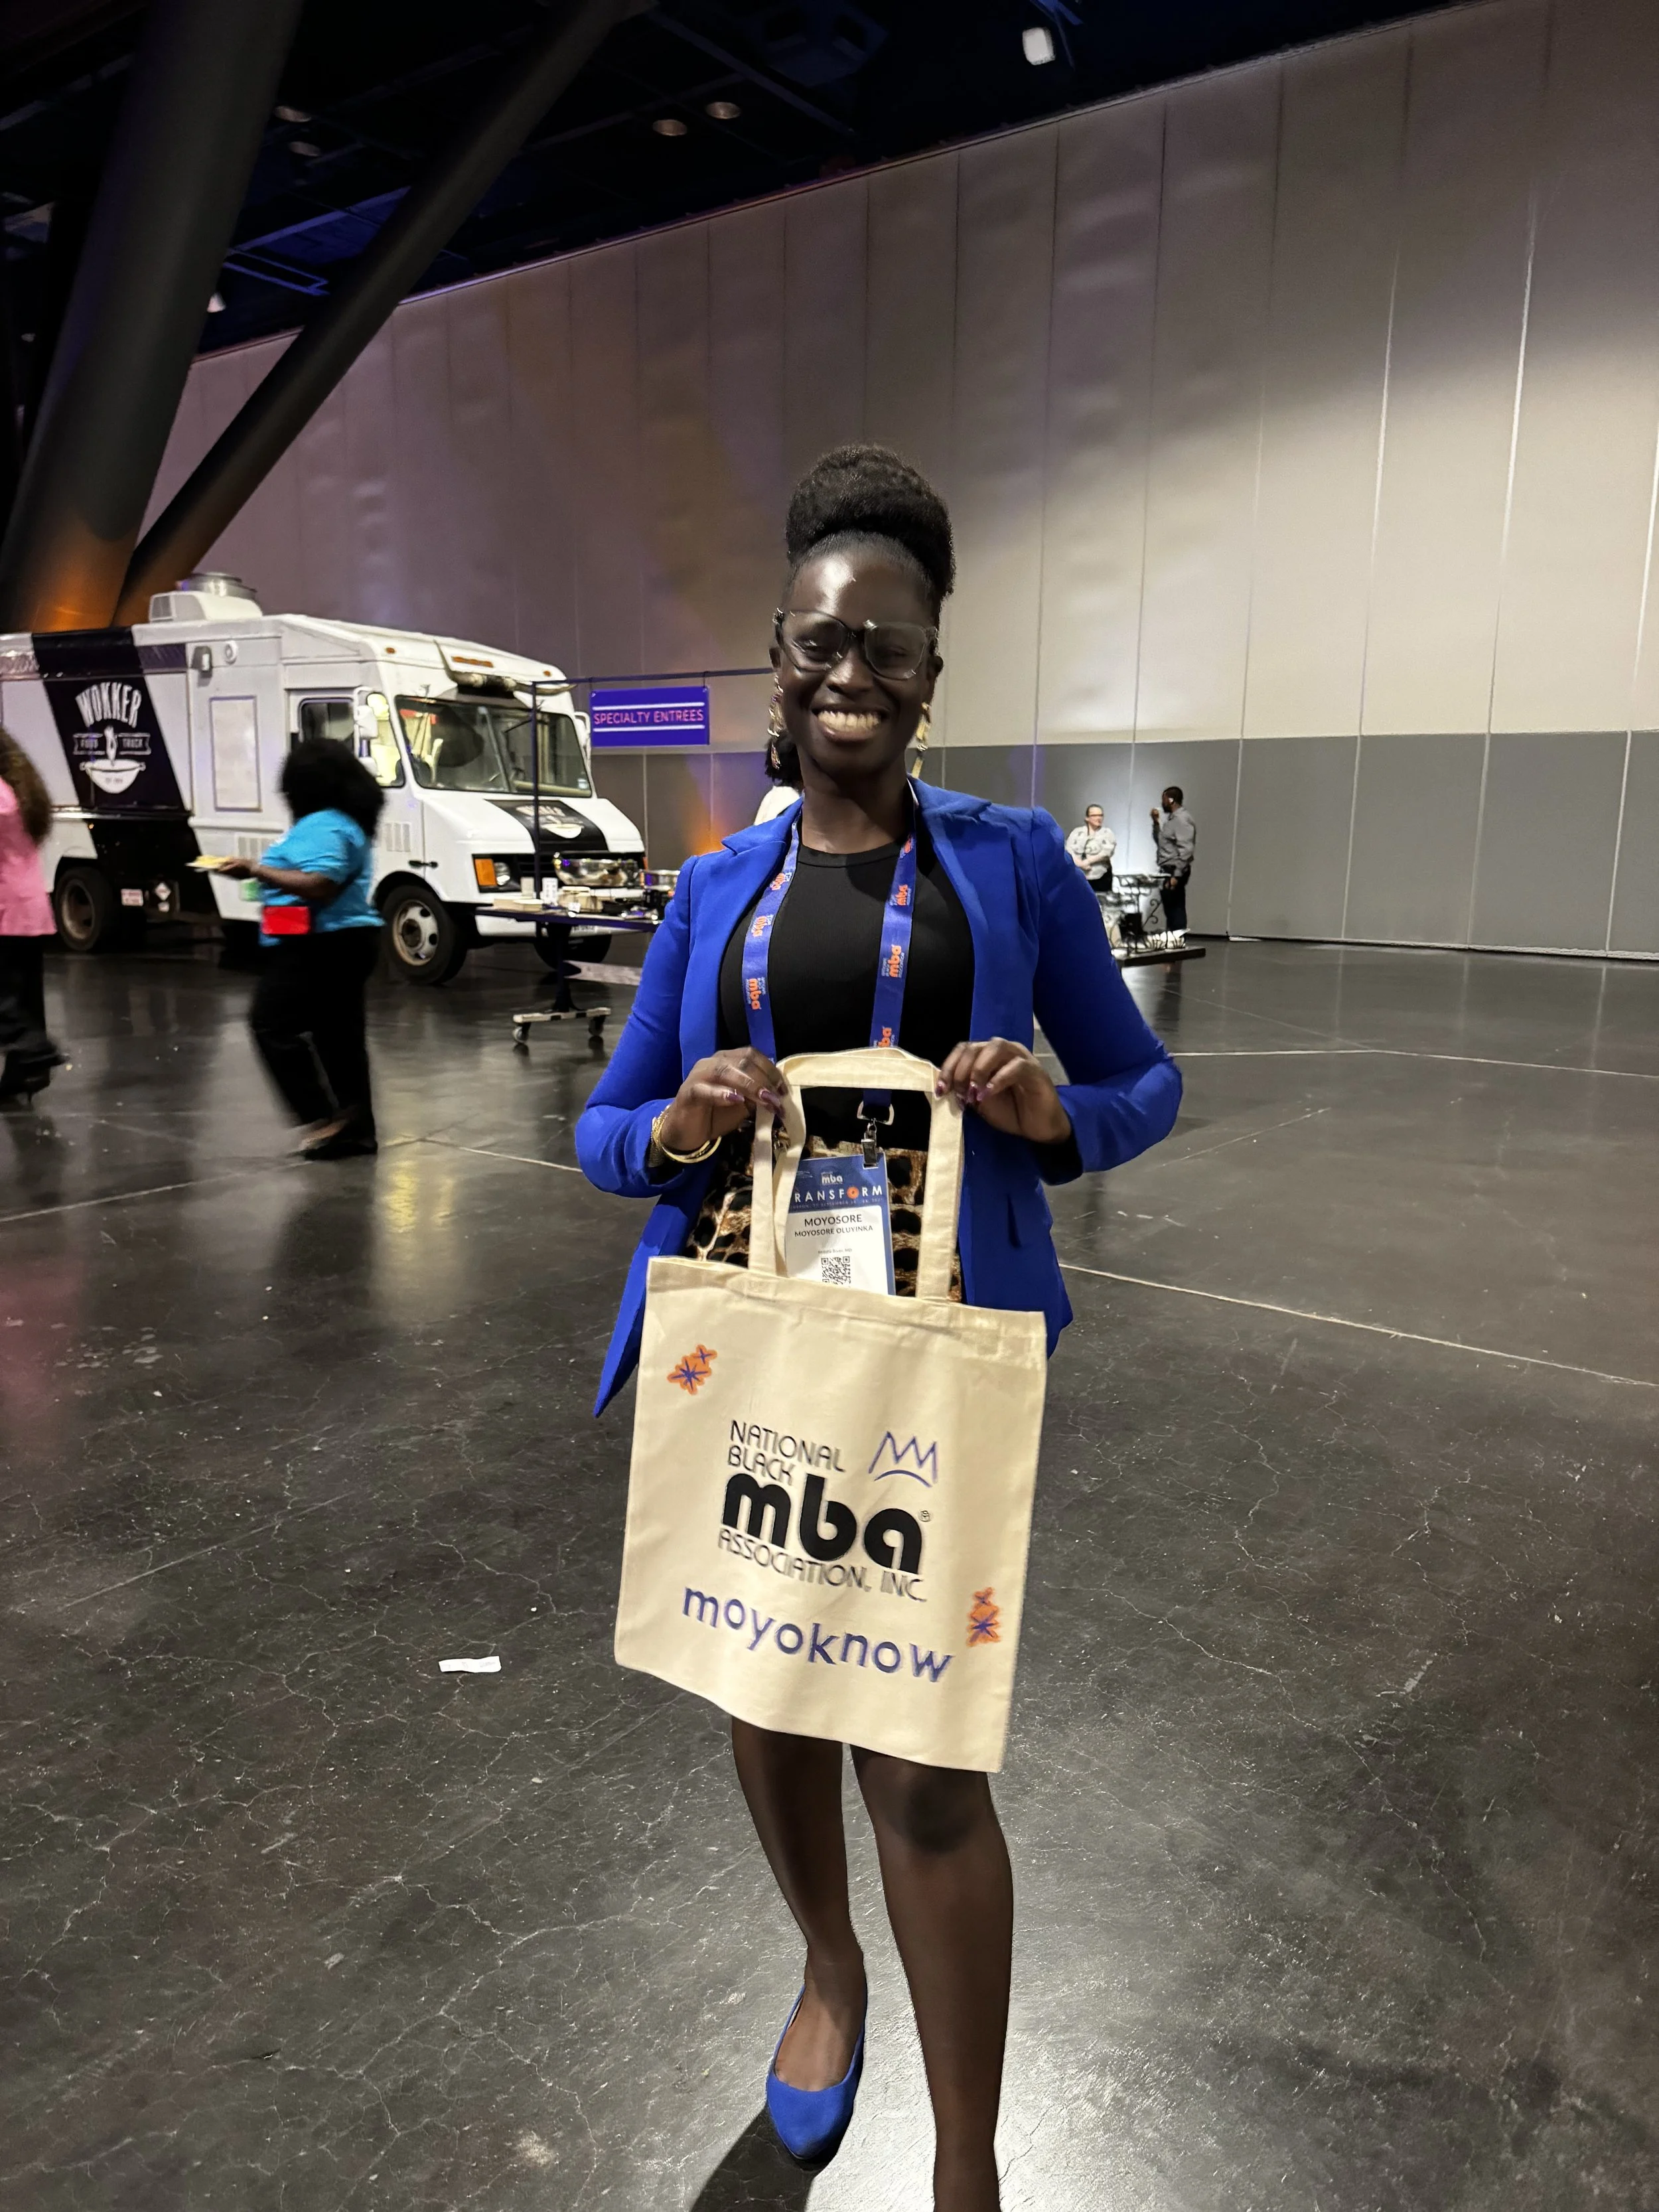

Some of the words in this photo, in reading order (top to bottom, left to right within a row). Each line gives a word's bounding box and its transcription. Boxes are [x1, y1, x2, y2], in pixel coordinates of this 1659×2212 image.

[75, 682, 142, 728] WOKKER
[594, 711, 650, 725] SPECIALTY
[654, 709, 704, 723] ENTREES
[888, 945, 902, 978] mba
[749, 978, 762, 1010] mba
[877, 1027, 892, 1047] ba
[794, 1185, 883, 1203] RANSFORM
[794, 1228, 835, 1237] MOYOSORE
[836, 1225, 873, 1234] OLUYINKA
[804, 1215, 863, 1227] MOYOSORE
[730, 1420, 846, 1473] NATIONAL
[728, 1445, 795, 1486] BLACK
[682, 1587, 956, 1682] moyoknow
